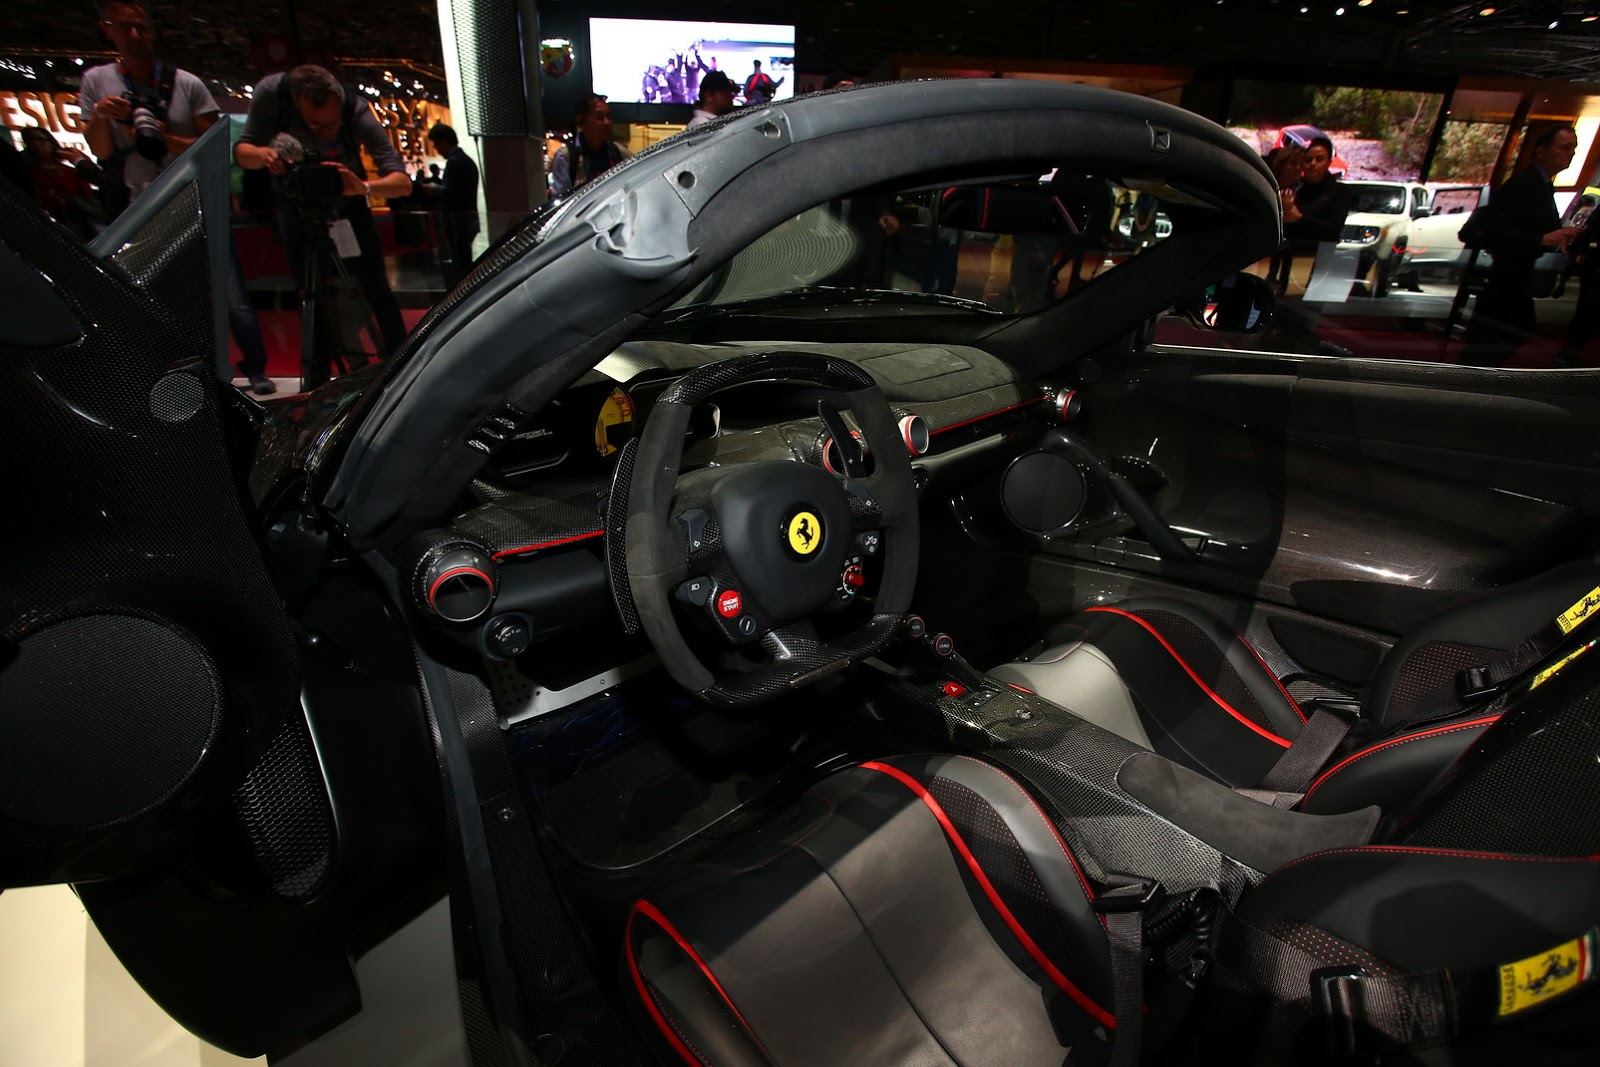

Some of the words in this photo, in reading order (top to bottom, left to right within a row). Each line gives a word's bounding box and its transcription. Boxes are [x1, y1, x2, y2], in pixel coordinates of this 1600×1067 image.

[0, 91, 87, 133] ESIG
[723, 597, 738, 606] ENGINE
[723, 602, 738, 612] START
